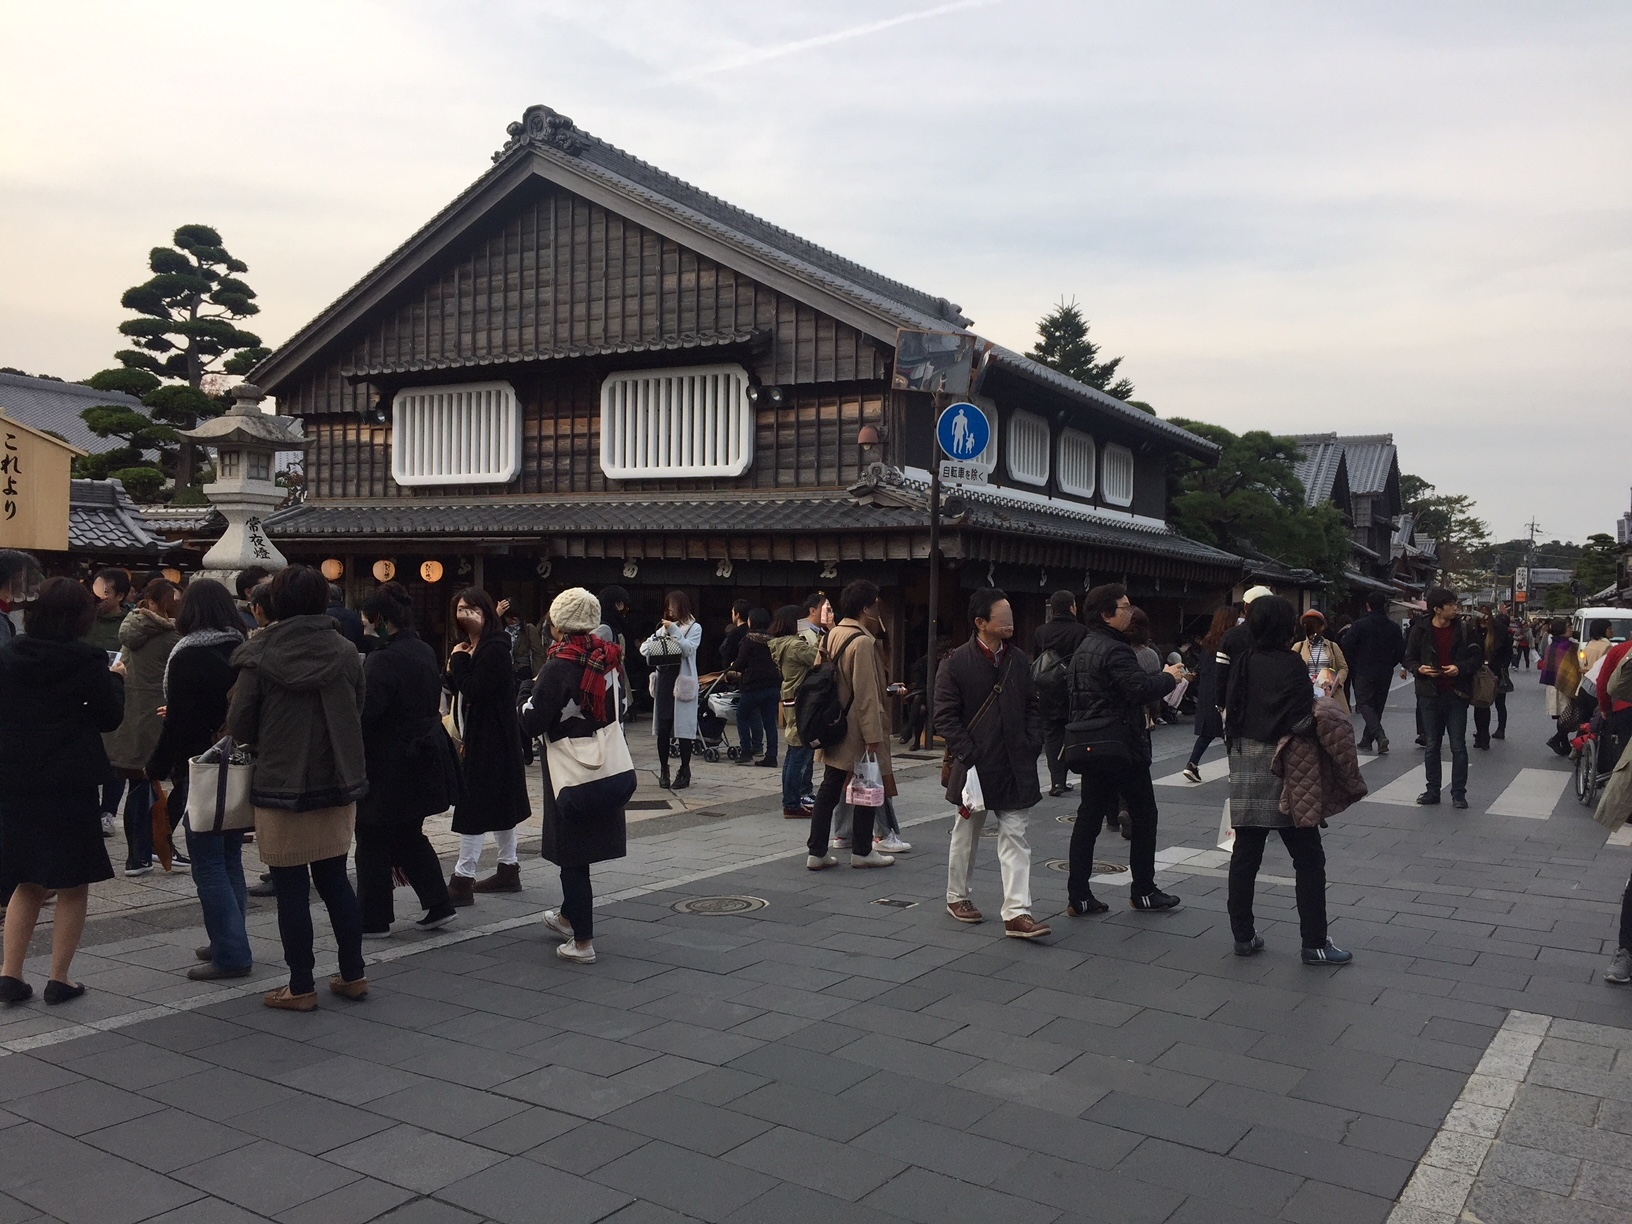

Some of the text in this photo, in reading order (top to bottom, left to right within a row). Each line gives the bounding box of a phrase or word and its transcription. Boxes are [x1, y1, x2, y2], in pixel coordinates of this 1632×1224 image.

[0, 433, 22, 520] これより
[943, 466, 984, 481] 自転車を除く
